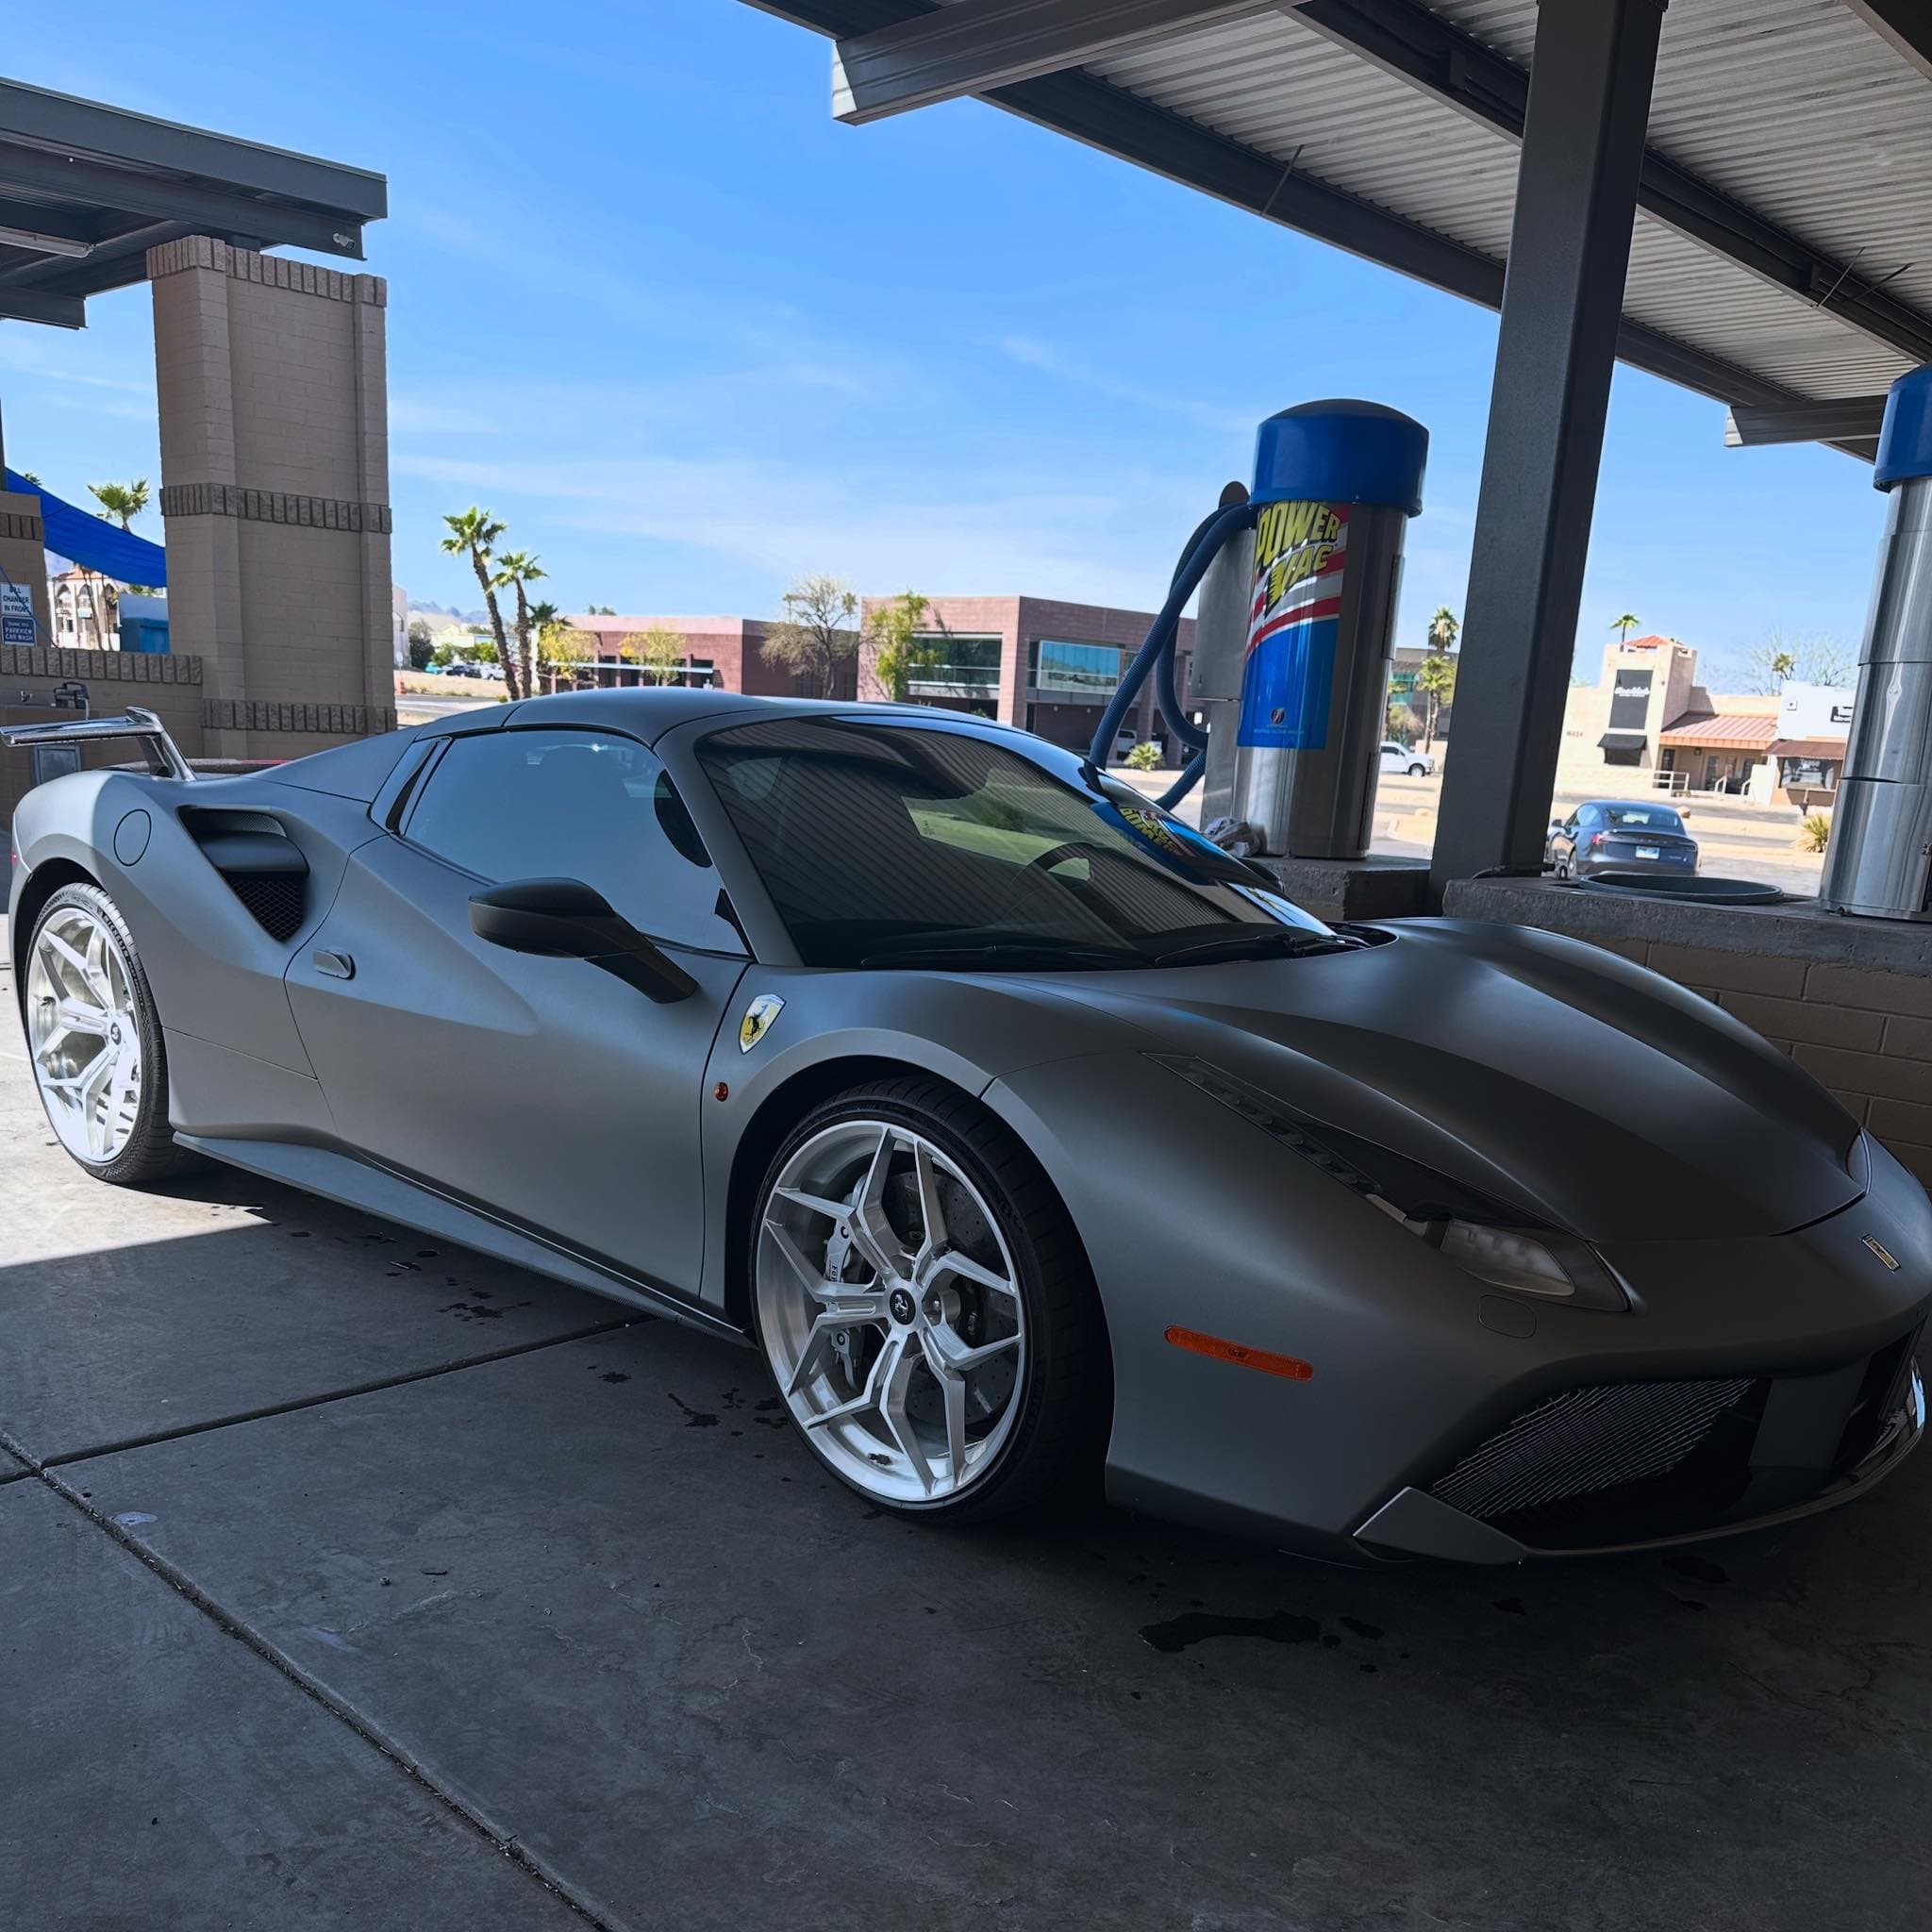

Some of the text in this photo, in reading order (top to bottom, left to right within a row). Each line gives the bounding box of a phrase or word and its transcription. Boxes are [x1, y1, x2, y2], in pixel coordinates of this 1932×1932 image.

[1255, 500, 1341, 568] POWER
[1266, 544, 1334, 611] VAC
[103, 913, 130, 958] MICHELIN
